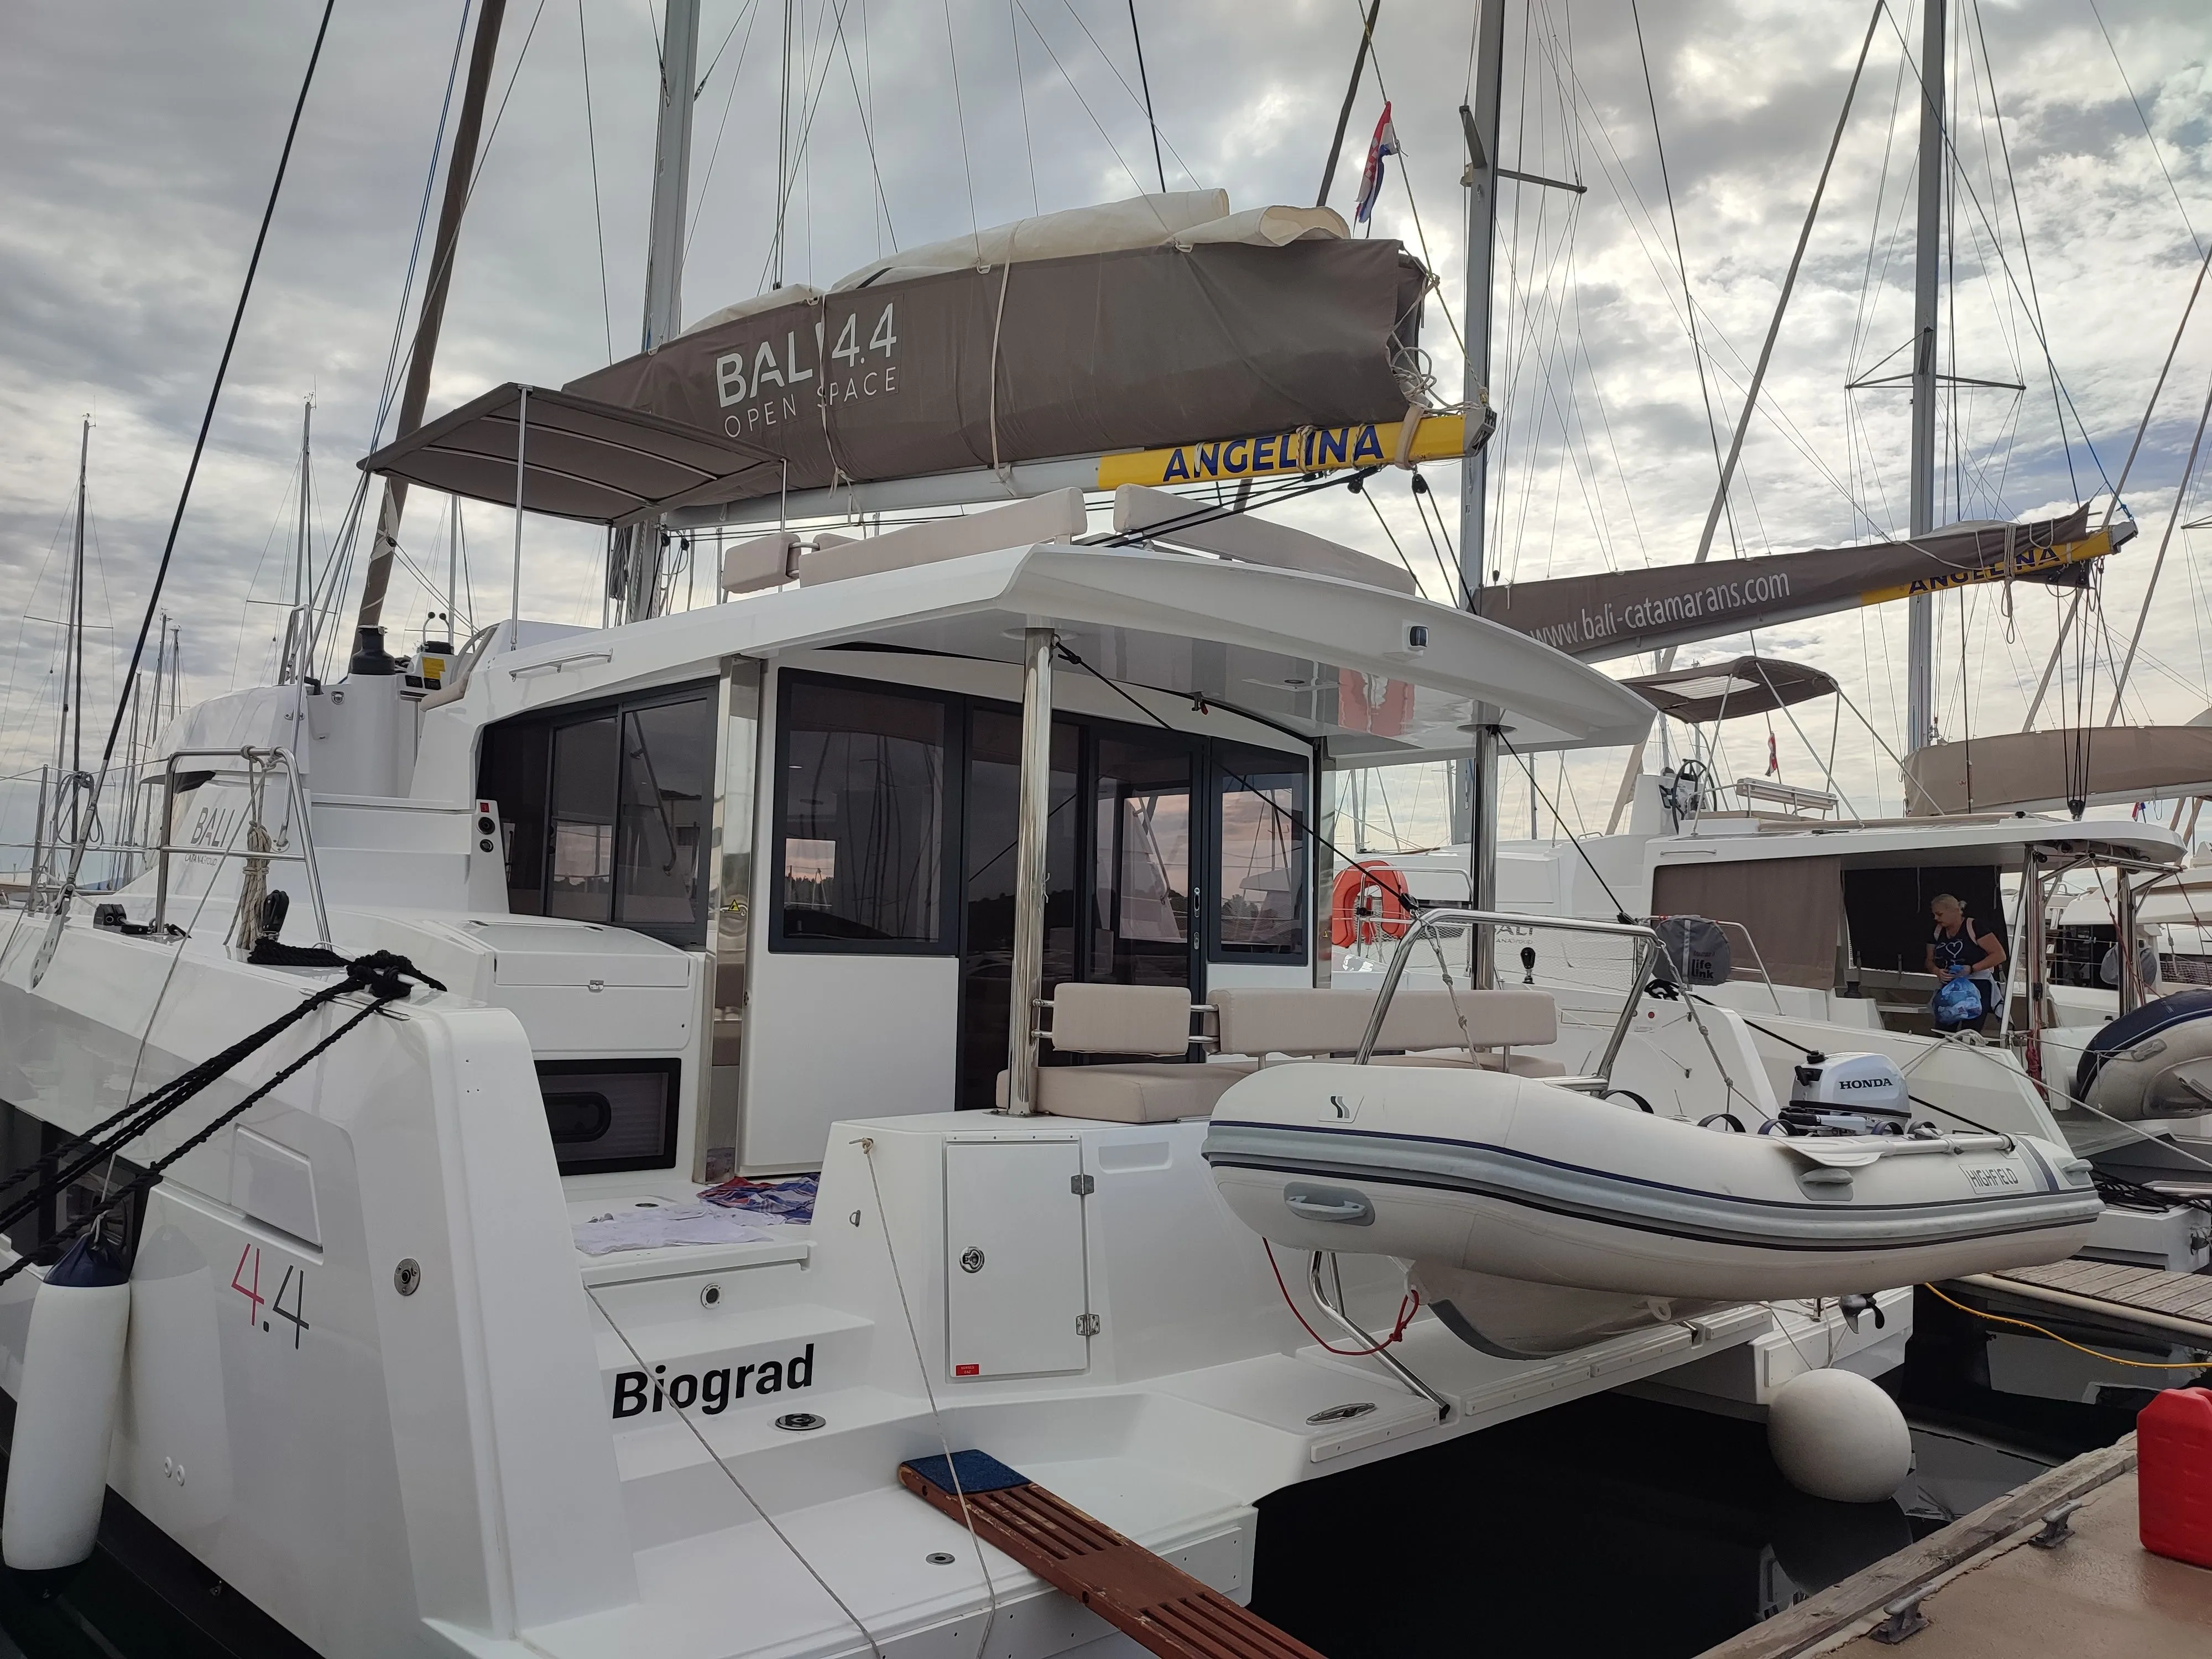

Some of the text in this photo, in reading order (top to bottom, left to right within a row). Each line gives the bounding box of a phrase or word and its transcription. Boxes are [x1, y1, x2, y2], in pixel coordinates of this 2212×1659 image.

[831, 302, 897, 368] 4.4
[724, 366, 896, 438] OPEN SPACE
[1162, 424, 1385, 482] ANGELINA
[190, 807, 236, 848] BALI
[1494, 925, 1533, 936] ALI
[1839, 1078, 1893, 1089] HONDA
[1965, 1167, 2019, 1187] HIGHFIELD
[231, 1243, 309, 1350] 4.4
[612, 1343, 815, 1420] Biograd
